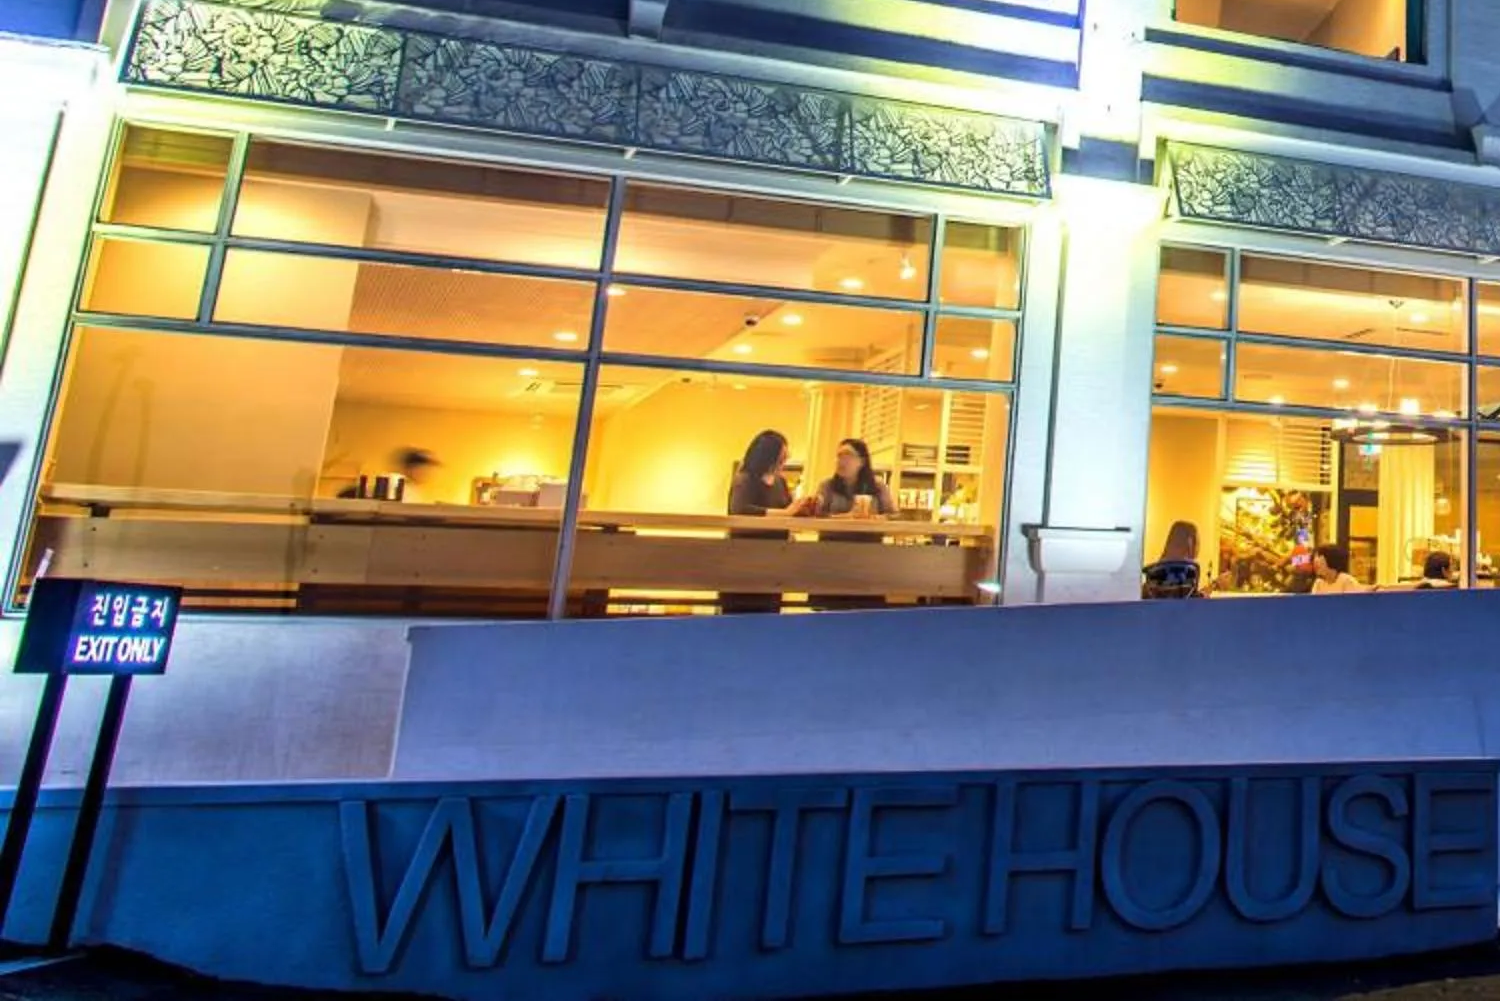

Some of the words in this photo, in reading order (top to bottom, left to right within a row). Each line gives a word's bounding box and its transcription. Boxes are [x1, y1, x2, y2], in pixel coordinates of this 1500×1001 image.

[91, 593, 170, 628] 진입금지
[73, 635, 120, 663] EXIT
[116, 635, 167, 663] ONLY
[338, 784, 962, 975] WHITE
[978, 773, 1496, 936] HOUSE
